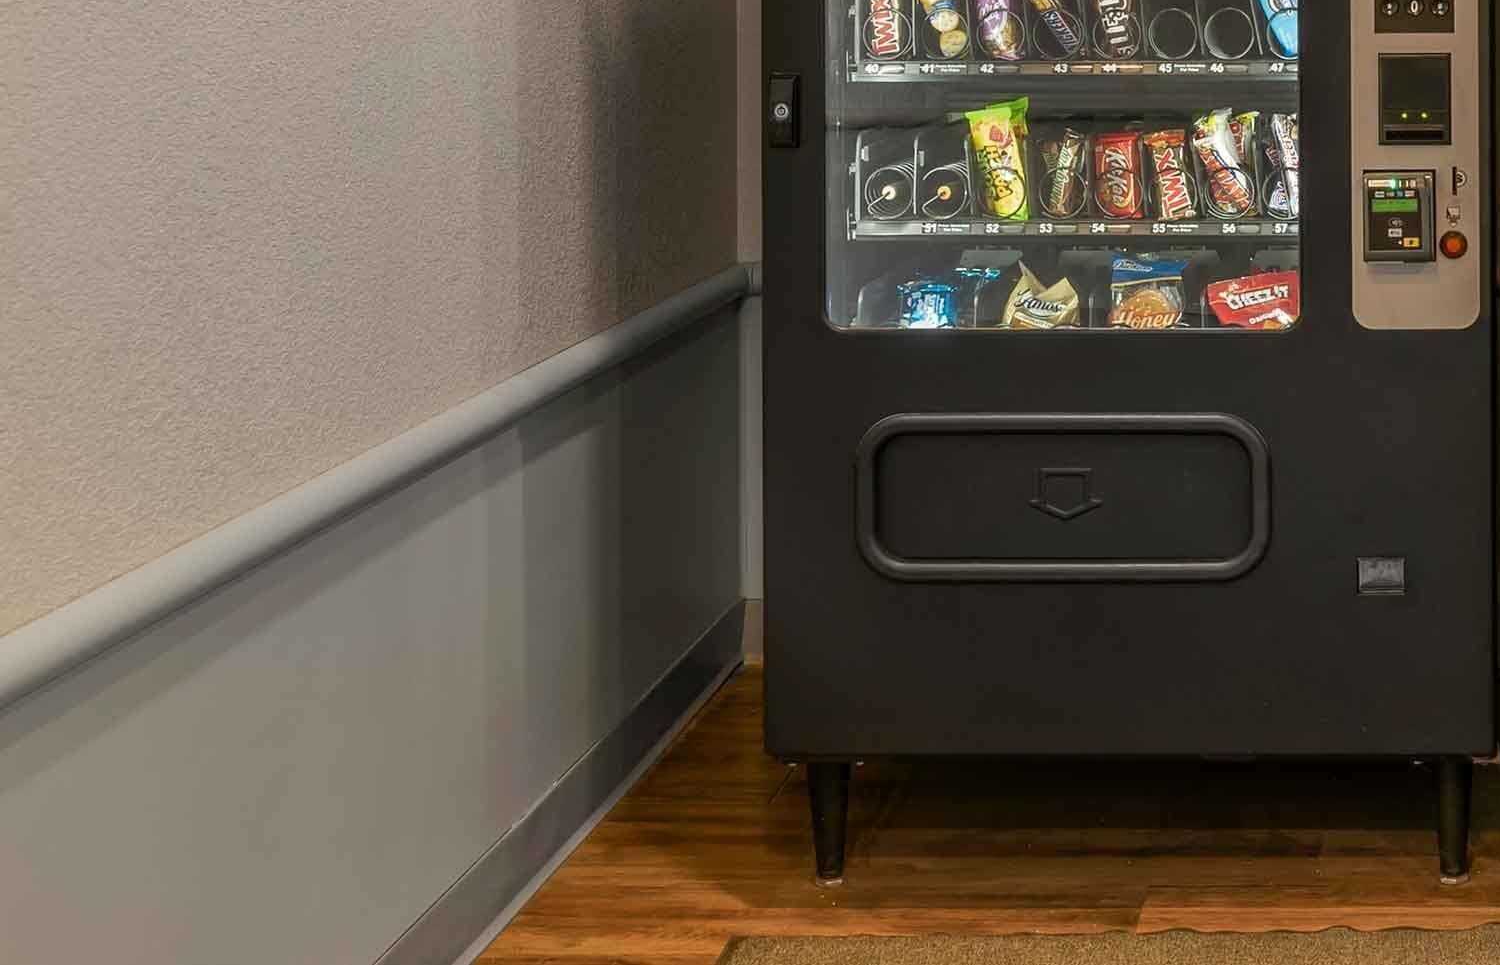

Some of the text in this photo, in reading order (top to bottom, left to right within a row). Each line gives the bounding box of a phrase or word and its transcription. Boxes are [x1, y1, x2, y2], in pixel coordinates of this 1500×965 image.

[1410, 0, 1419, 13] 0
[922, 64, 935, 73] 41
[980, 64, 994, 73] 42
[1054, 64, 1068, 73] 43
[1159, 64, 1172, 73] 45
[1210, 64, 1224, 73] 46
[1270, 64, 1284, 73] 47
[1155, 148, 1191, 218] TWIX
[924, 224, 937, 233] 51
[986, 223, 999, 233] 52
[1040, 223, 1053, 233] 53
[1092, 223, 1105, 233] 54
[1153, 223, 1166, 233] 55
[1223, 223, 1236, 233] 56
[1275, 223, 1287, 233] 57
[1113, 310, 1177, 330] Honey
